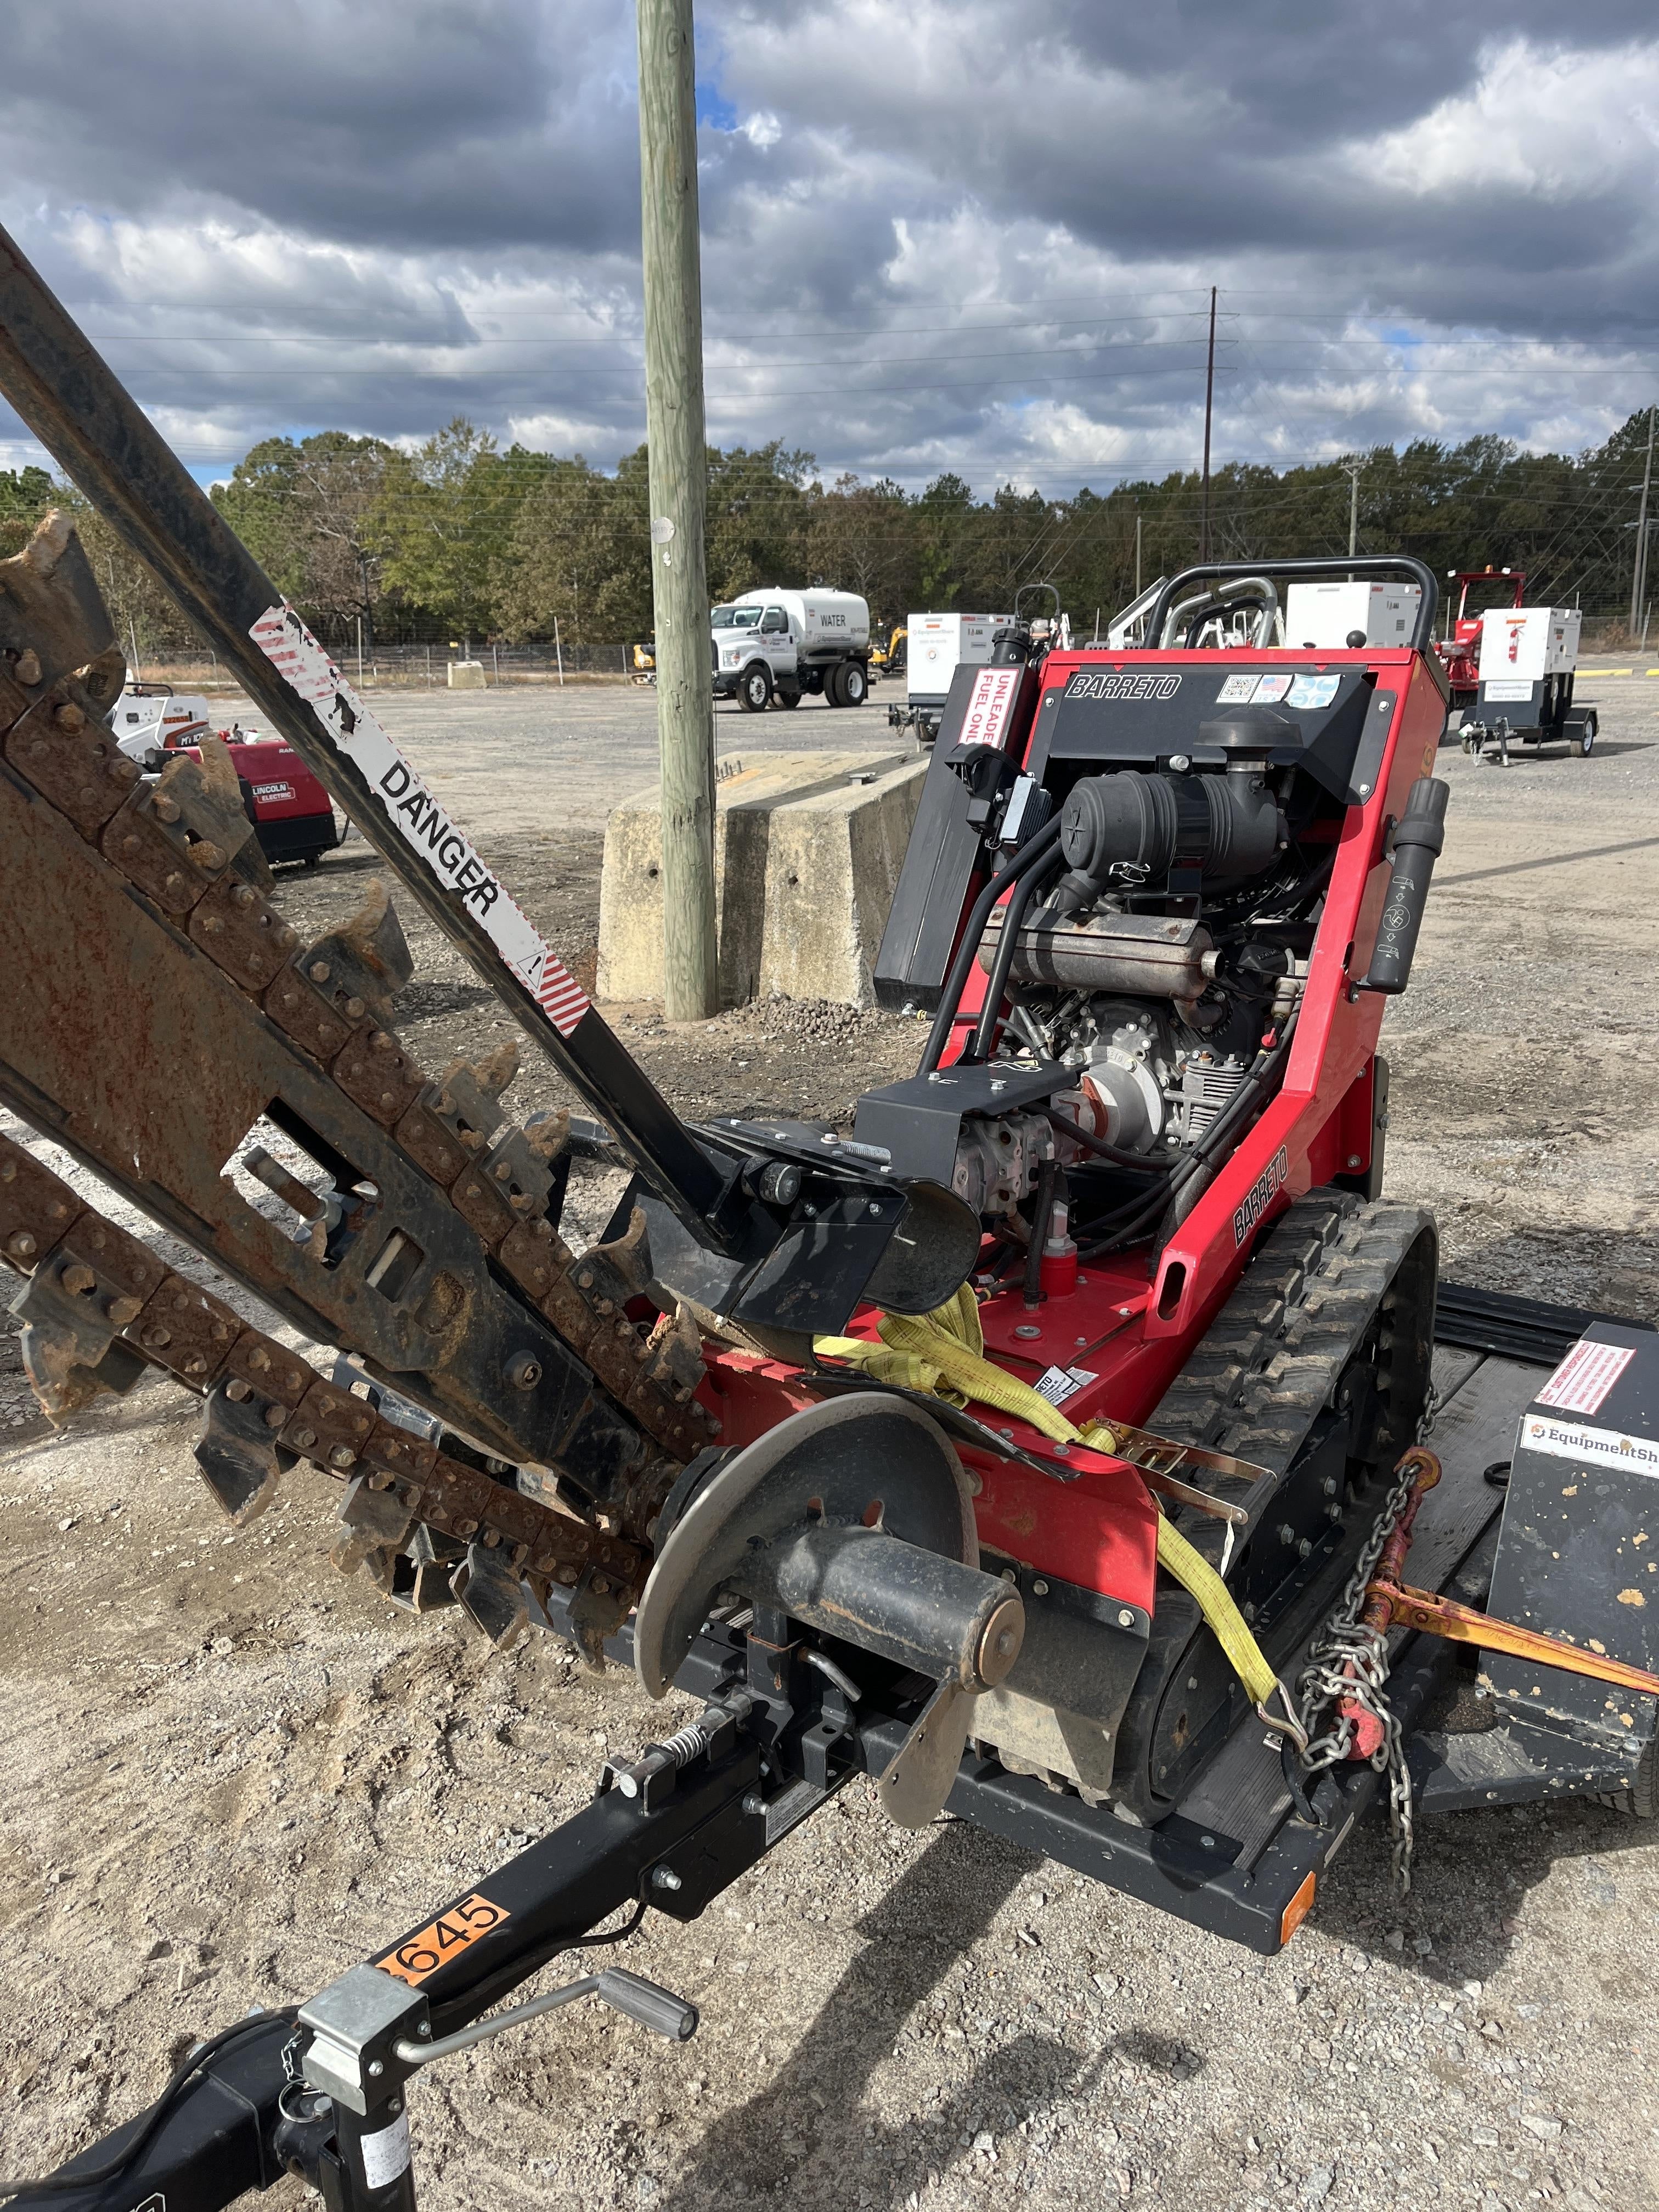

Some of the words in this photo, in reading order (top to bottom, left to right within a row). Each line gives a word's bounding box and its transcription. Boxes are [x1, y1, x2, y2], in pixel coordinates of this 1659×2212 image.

[821, 614, 846, 627] WATER
[975, 675, 994, 709] FUEL
[1065, 674, 1182, 699] BARRETO
[966, 713, 983, 743] ONL
[253, 785, 286, 795] LINCOLN
[262, 792, 291, 801] ELECTRIC
[380, 759, 498, 917] DANGER
[1233, 1144, 1288, 1249] BARRETO
[1036, 1376, 1052, 1392] RETO
[1551, 1369, 1572, 1389] CUSTOMER
[1549, 1428, 1659, 1463] EquipmentSh
[383, 1898, 499, 1982] 645
